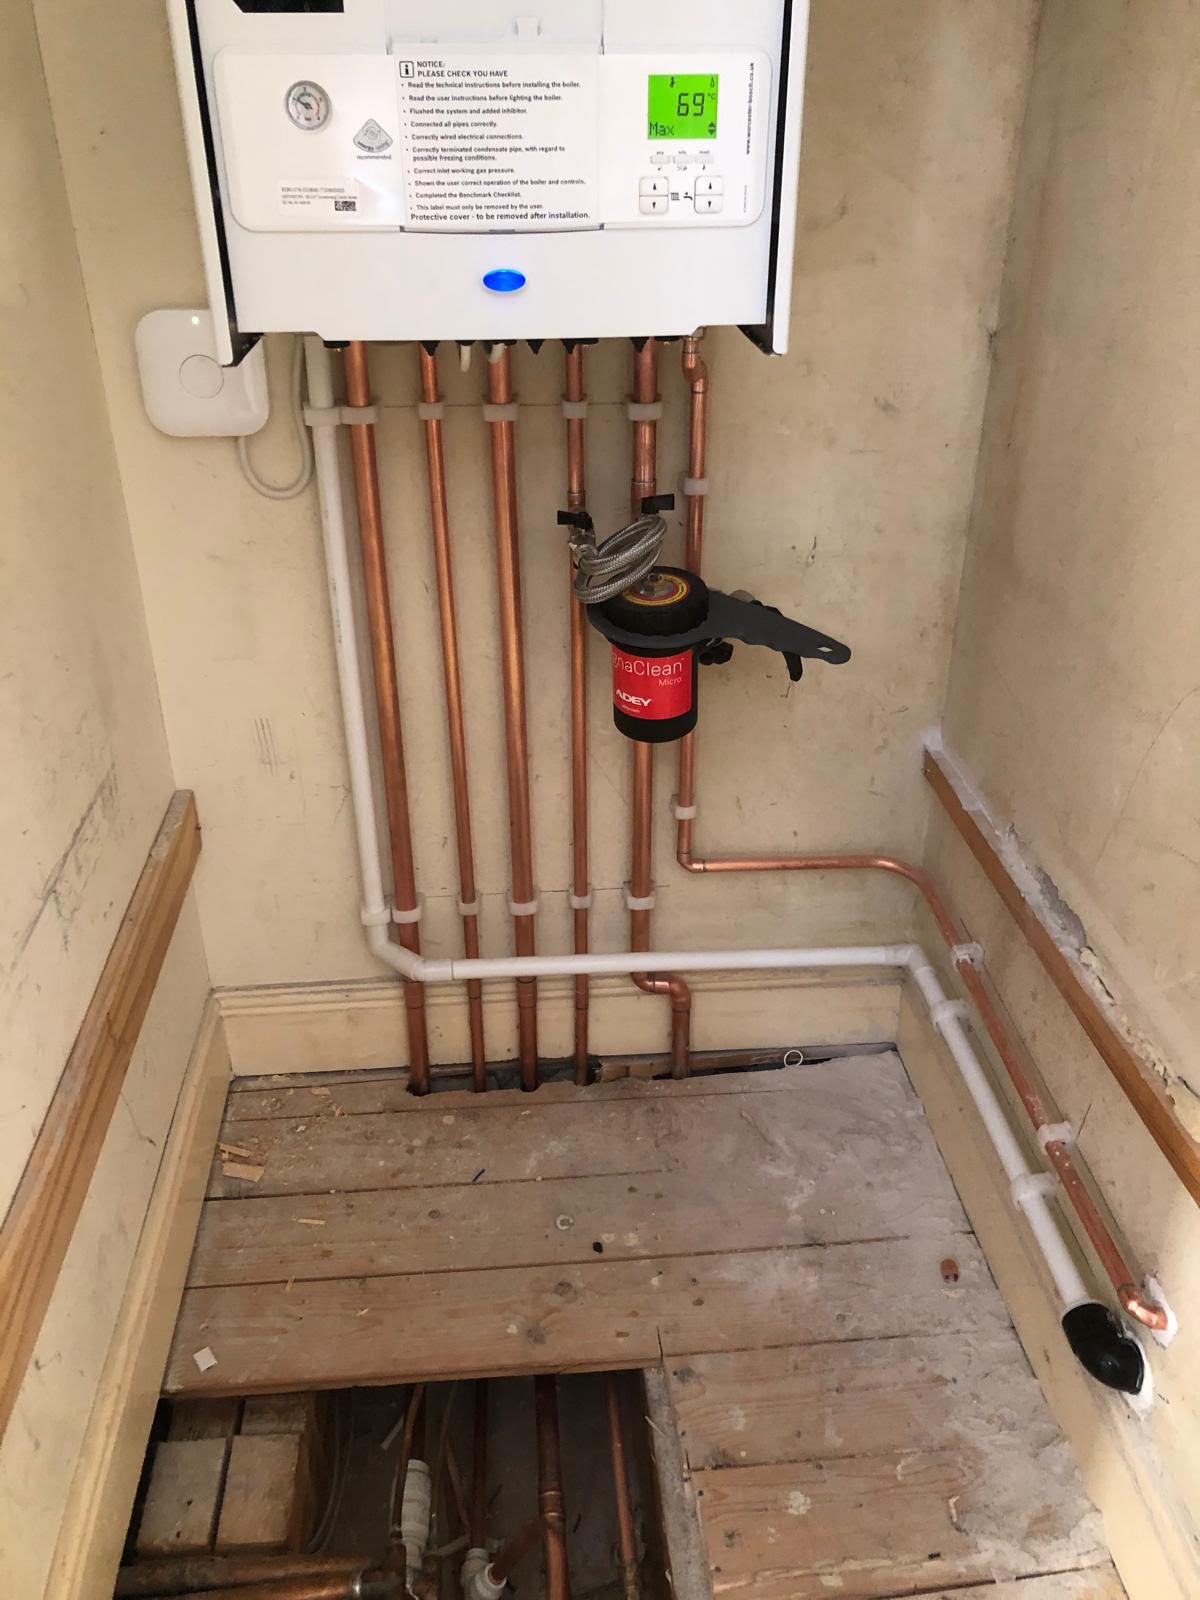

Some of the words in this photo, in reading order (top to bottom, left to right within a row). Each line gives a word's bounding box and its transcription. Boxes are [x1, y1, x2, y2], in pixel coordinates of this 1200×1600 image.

[523, 81, 550, 89] installing
[677, 92, 705, 117] 69
[746, 62, 754, 155] www.worcester-bosch.co.uk
[649, 122, 675, 136] Max
[658, 677, 682, 687] Micro
[616, 689, 652, 706] ADEY
